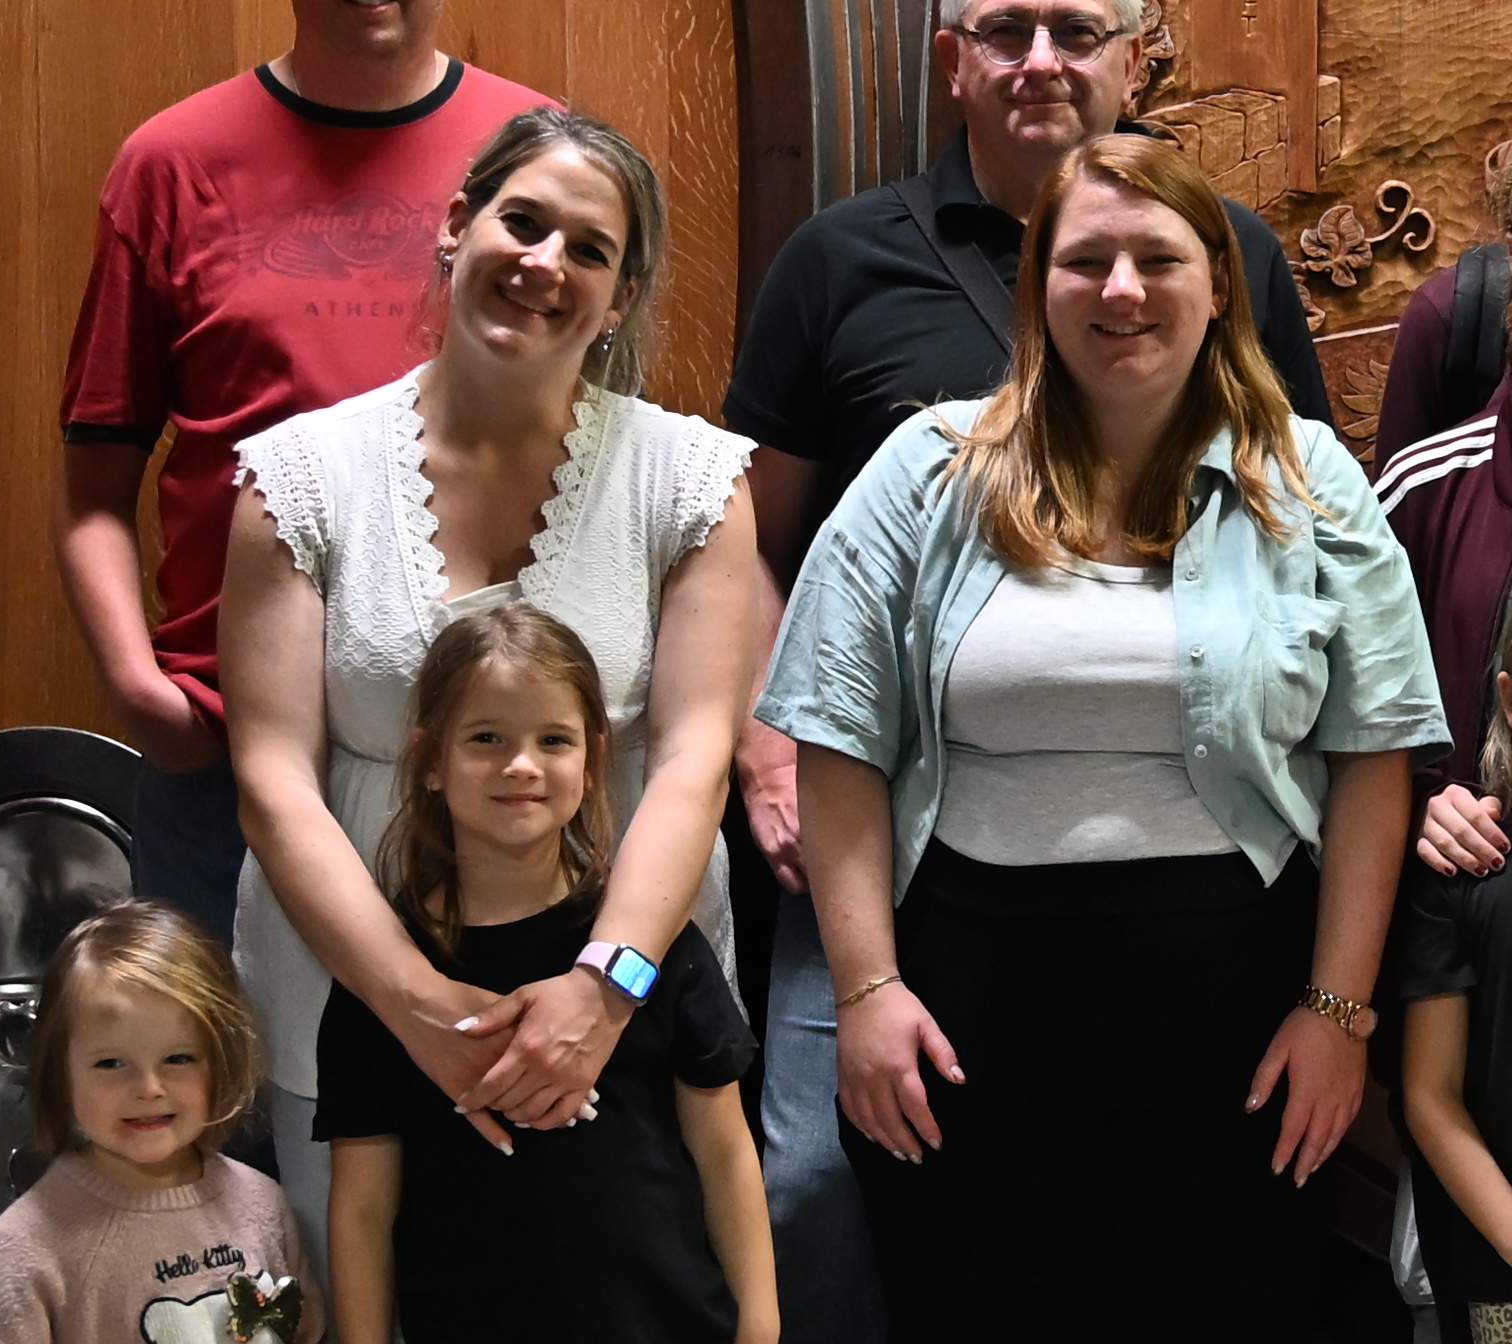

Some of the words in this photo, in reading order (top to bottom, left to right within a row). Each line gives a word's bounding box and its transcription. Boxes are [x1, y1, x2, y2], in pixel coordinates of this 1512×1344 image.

[290, 205, 368, 234] Hard
[304, 300, 422, 318] ATHEN
[154, 1253, 199, 1284] Hello
[202, 1243, 246, 1272] Kitty
